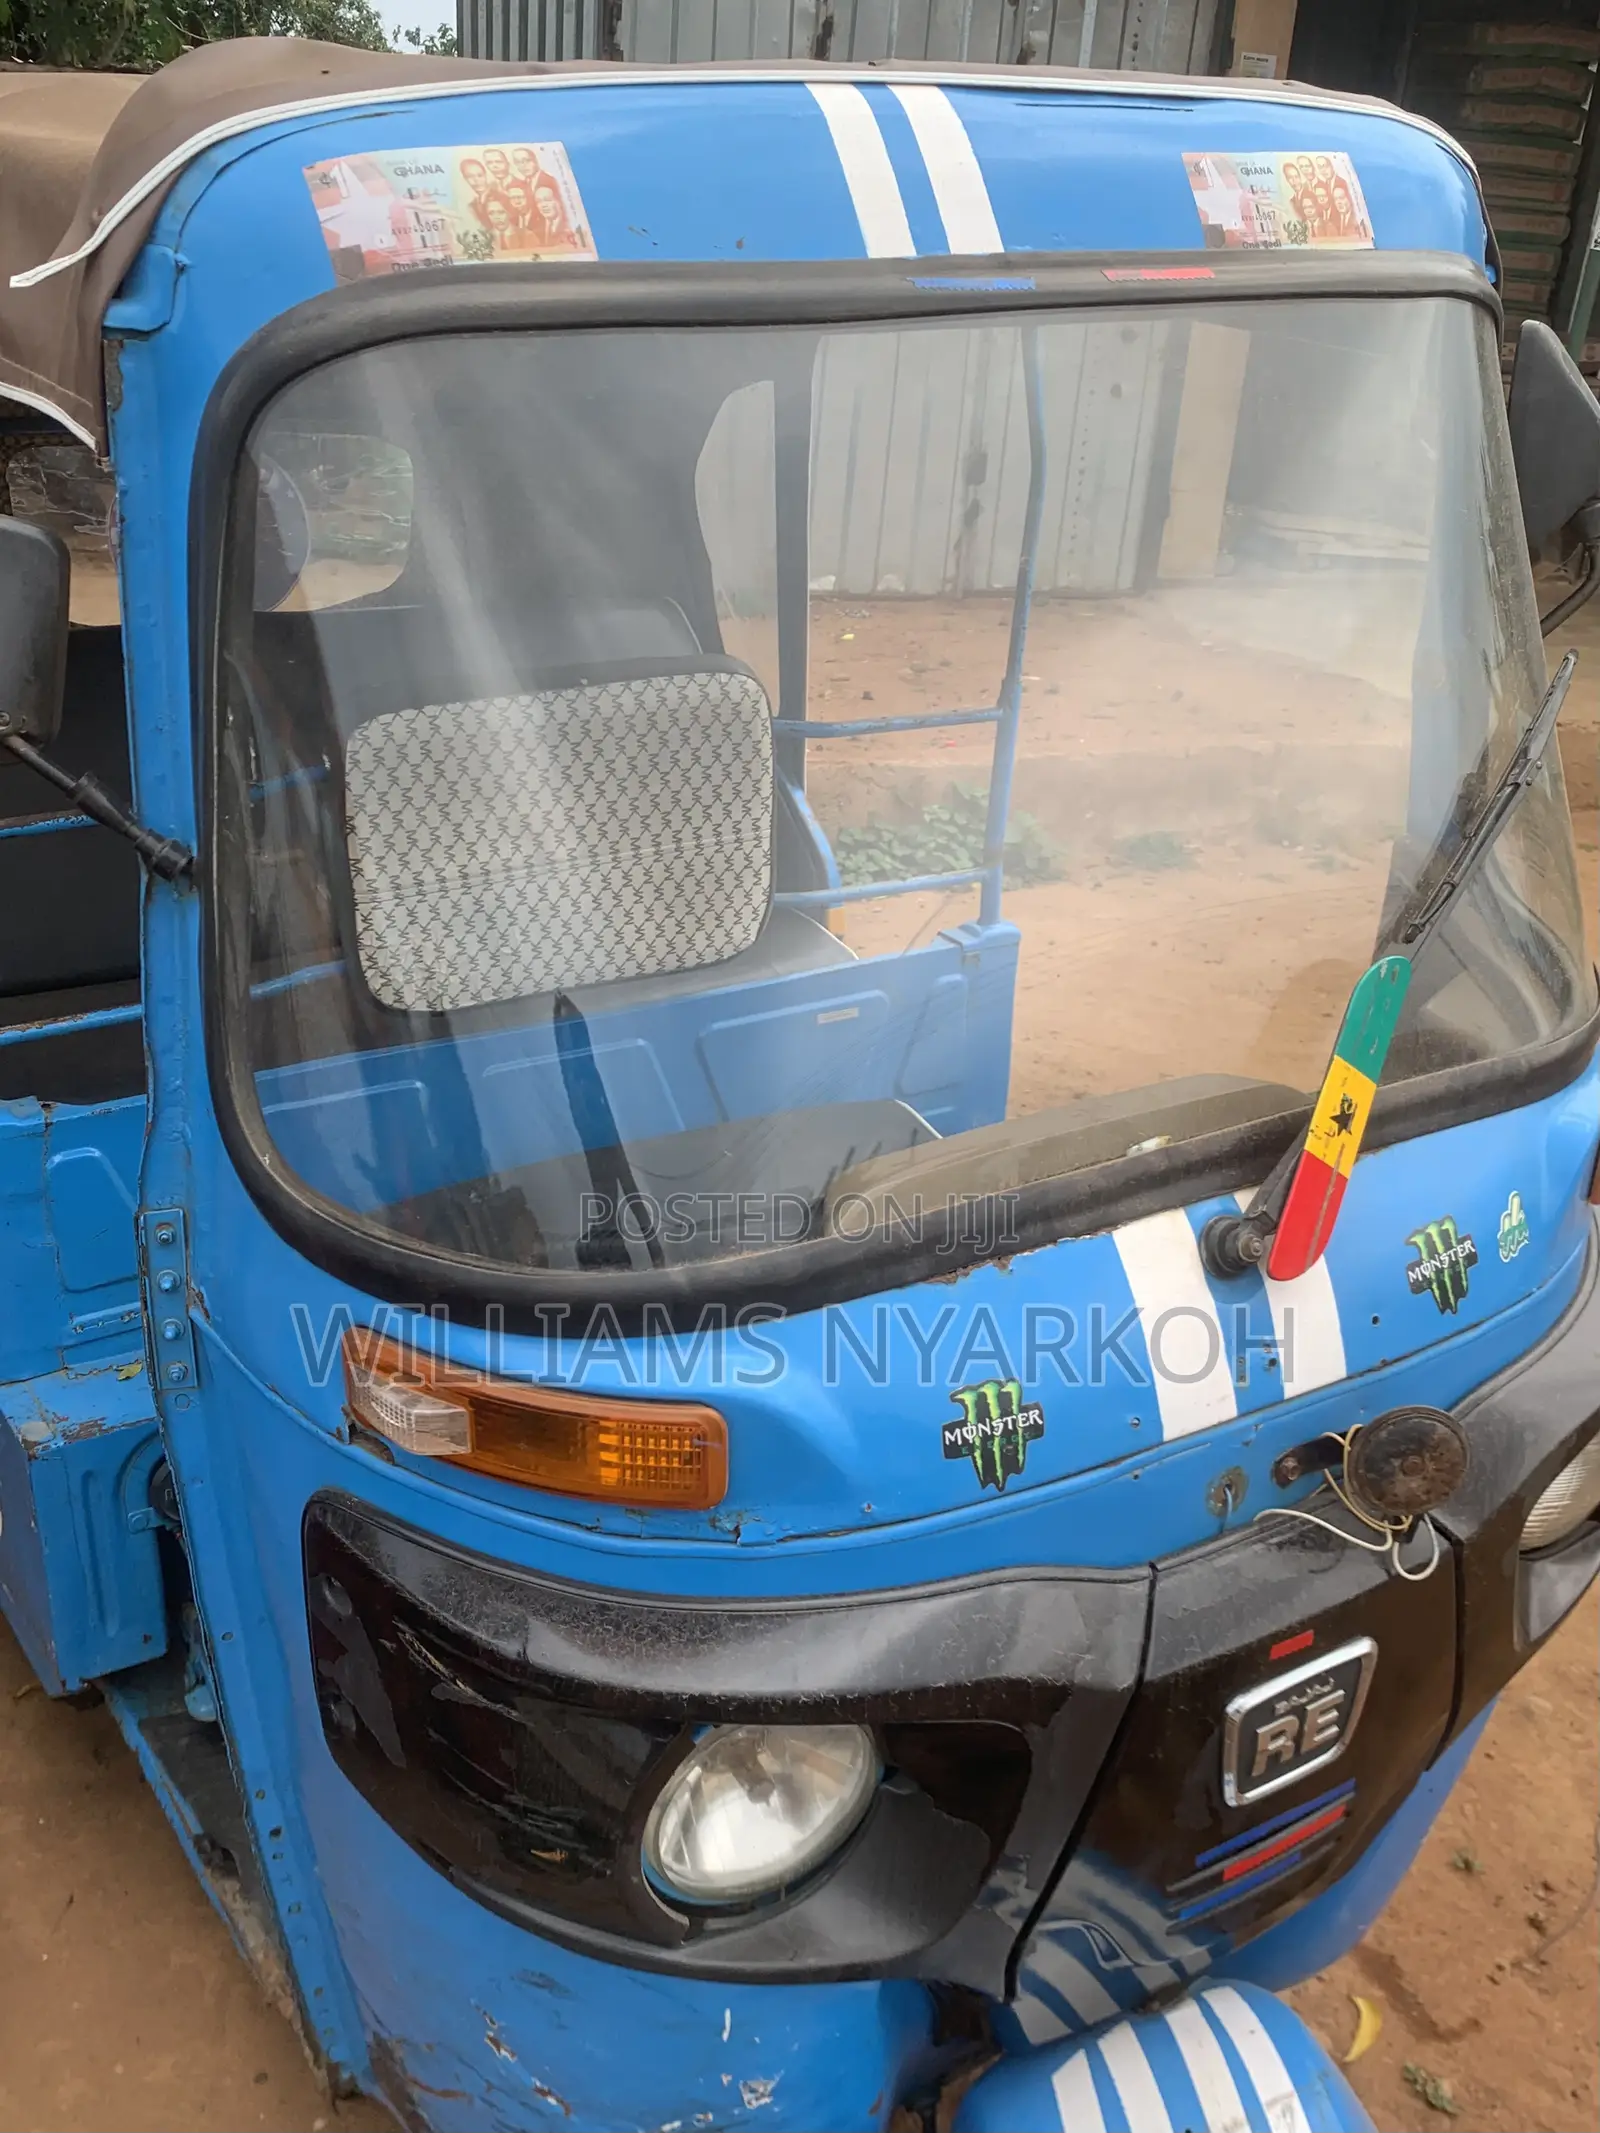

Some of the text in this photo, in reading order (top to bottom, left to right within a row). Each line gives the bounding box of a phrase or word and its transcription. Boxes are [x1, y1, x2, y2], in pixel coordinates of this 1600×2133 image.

[393, 164, 446, 178] GHANA
[1240, 166, 1274, 177] GHANA
[1408, 1239, 1477, 1284] MONSTER
[943, 1408, 1044, 1446] MONSTER
[1252, 1689, 1346, 1777] RE
